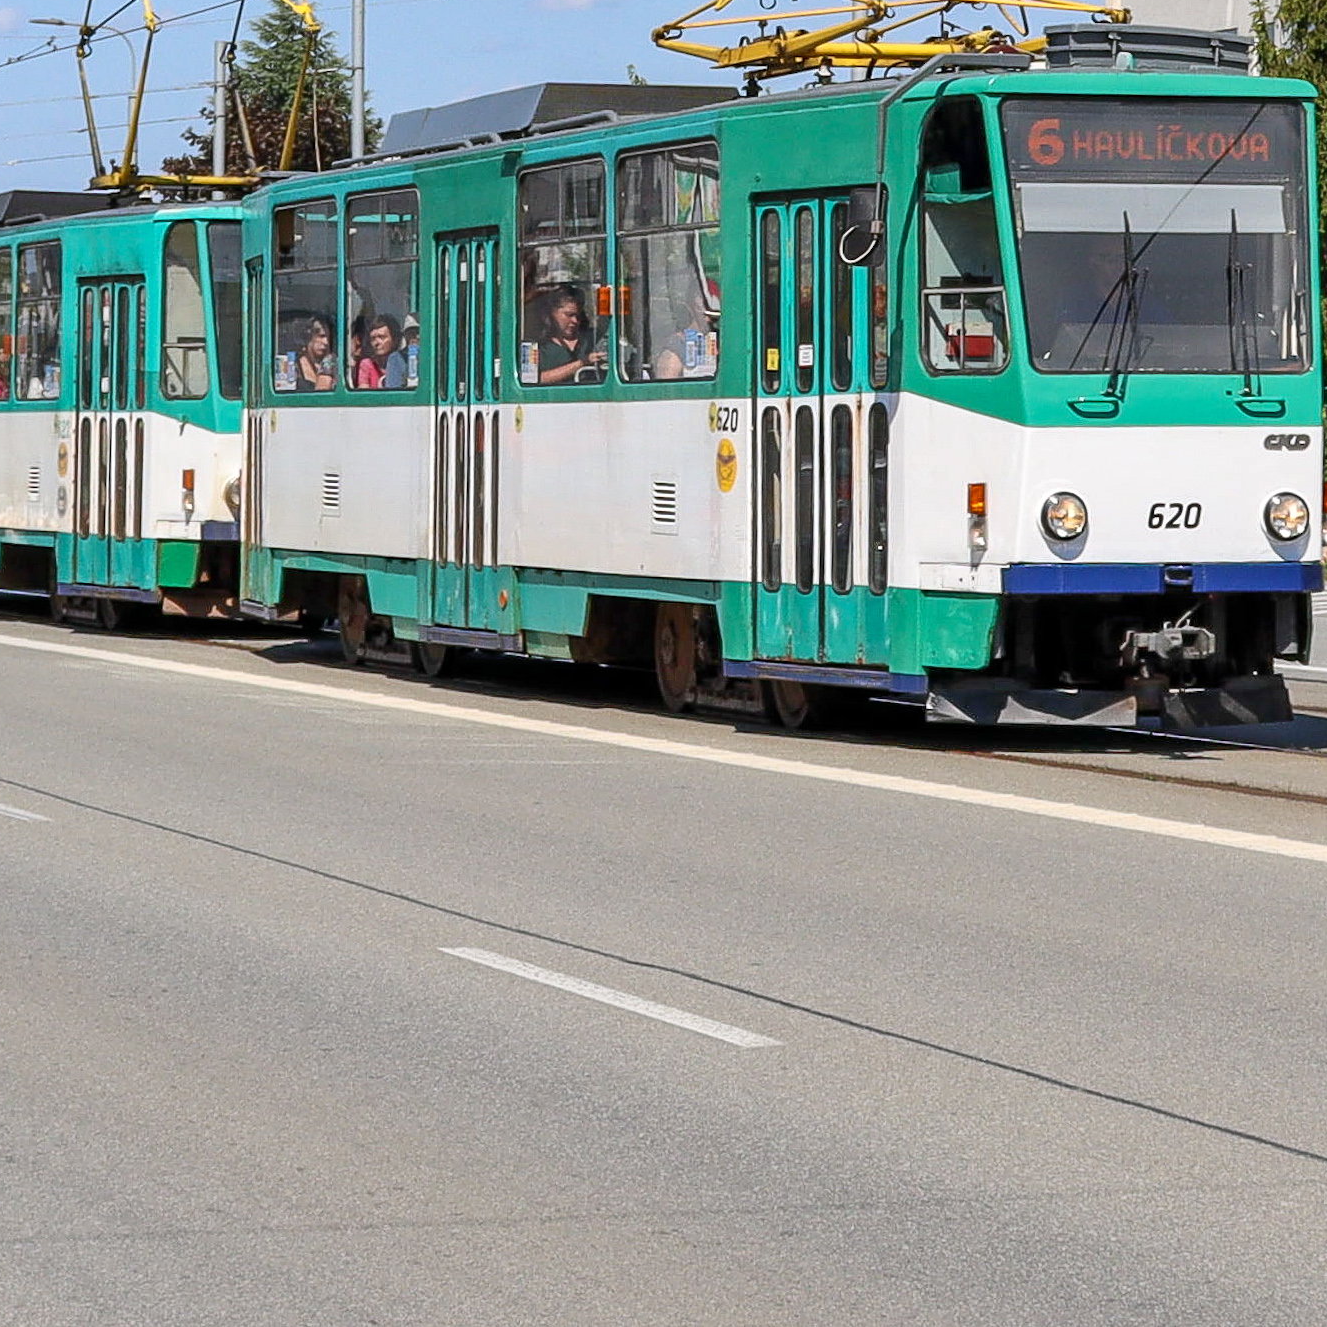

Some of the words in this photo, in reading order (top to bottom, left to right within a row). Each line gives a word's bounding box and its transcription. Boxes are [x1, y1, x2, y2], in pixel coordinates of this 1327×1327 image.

[1027, 118, 1065, 165] 6
[1074, 125, 1269, 161] HAVLÍČKOVA
[716, 407, 739, 433] 620
[1148, 502, 1202, 529] 620
